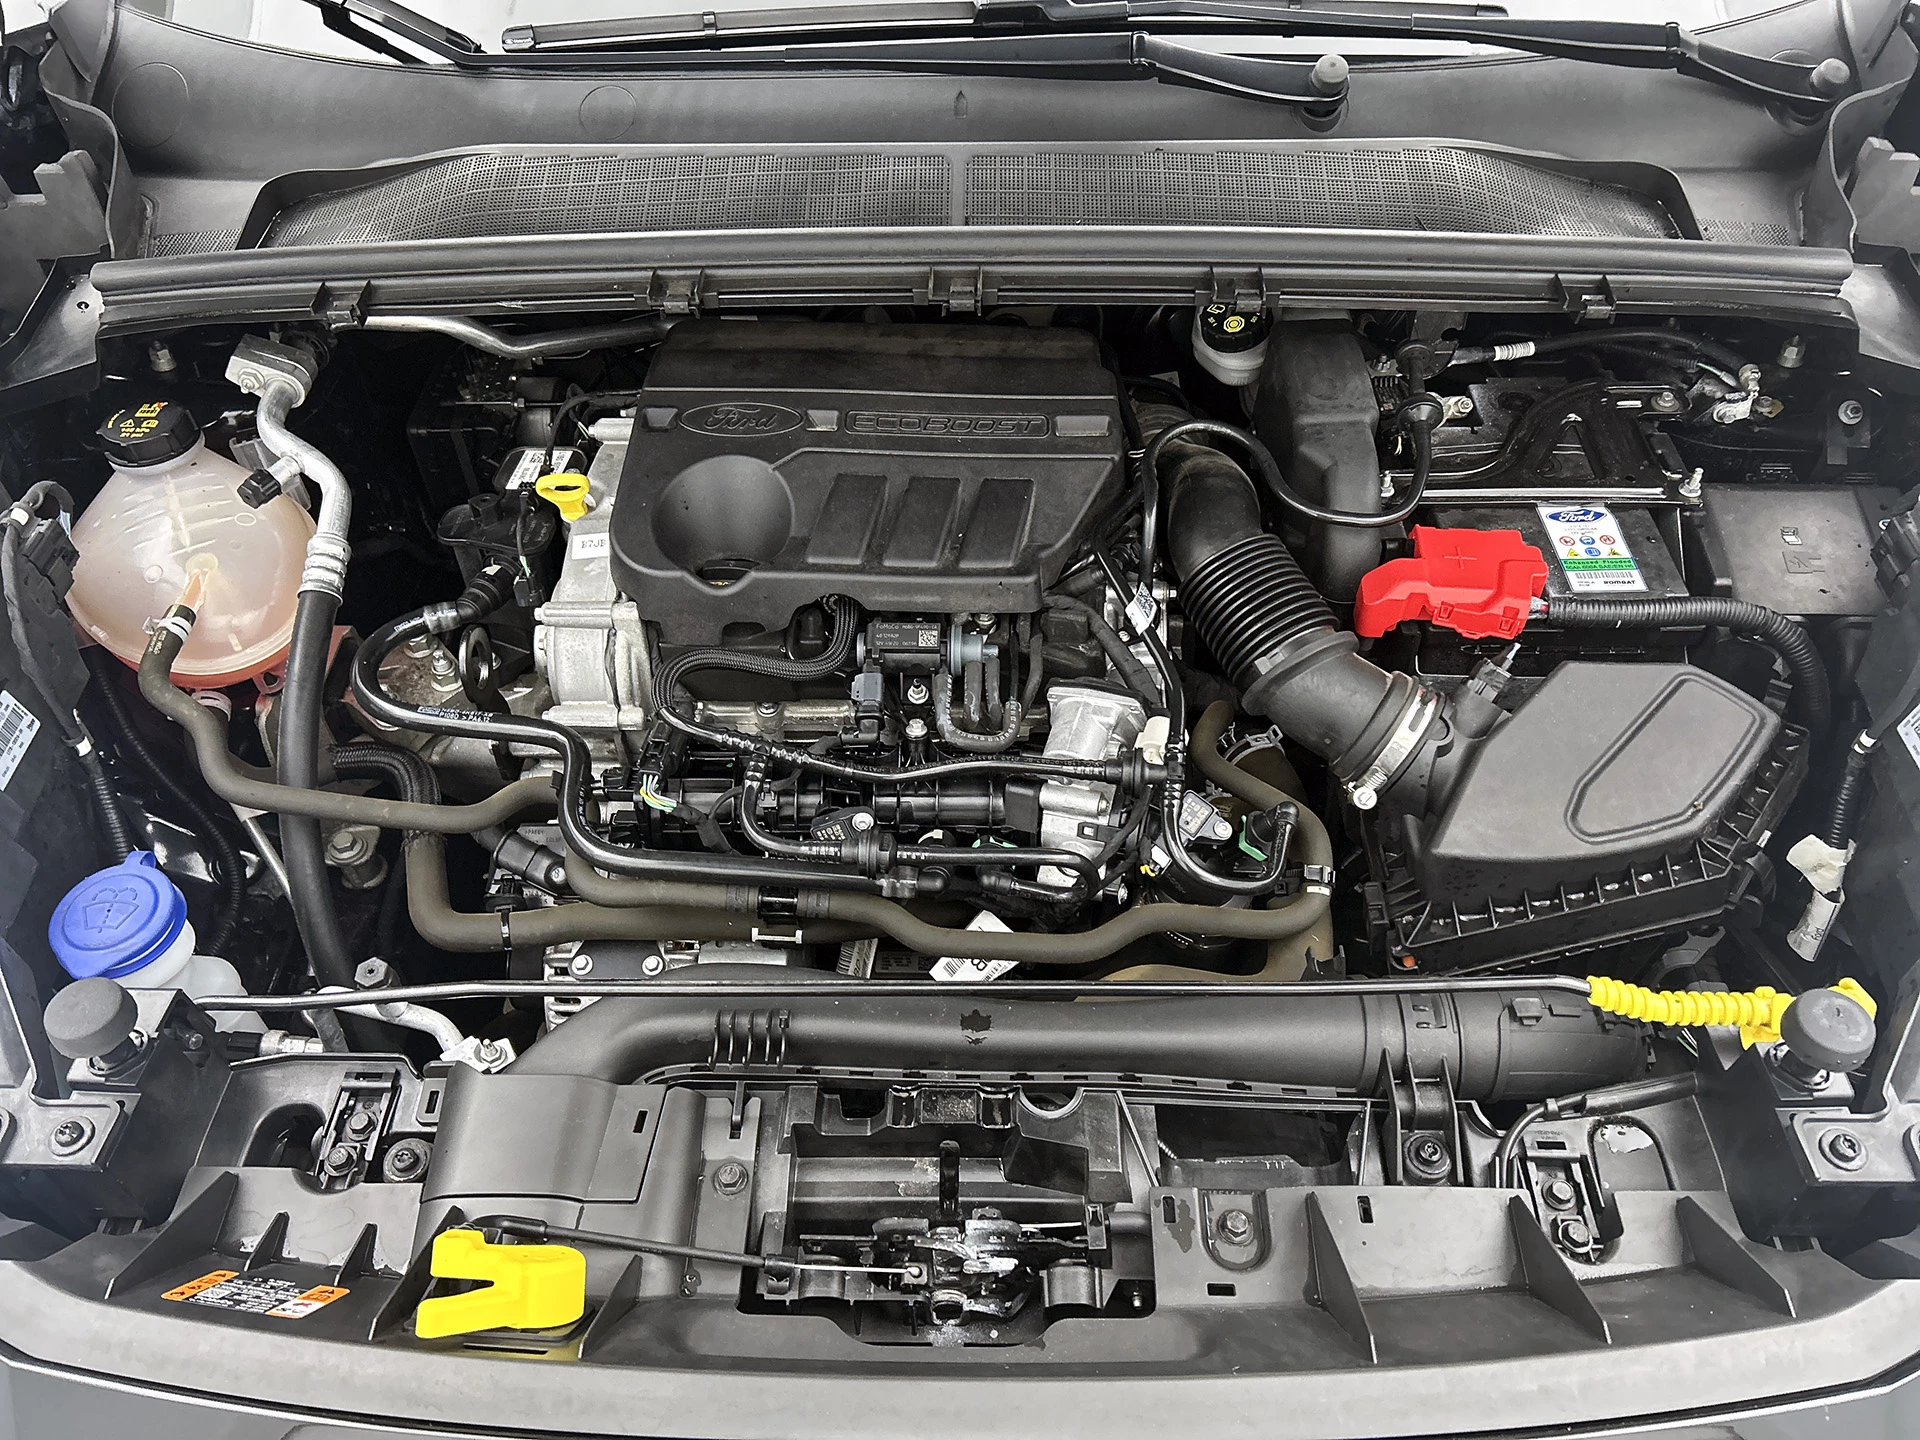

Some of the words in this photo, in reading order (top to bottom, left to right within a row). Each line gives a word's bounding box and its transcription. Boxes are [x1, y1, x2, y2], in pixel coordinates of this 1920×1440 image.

[703, 407, 778, 430] Ford
[852, 413, 1043, 433] ECOBOOST
[1558, 509, 1595, 521] Ford
